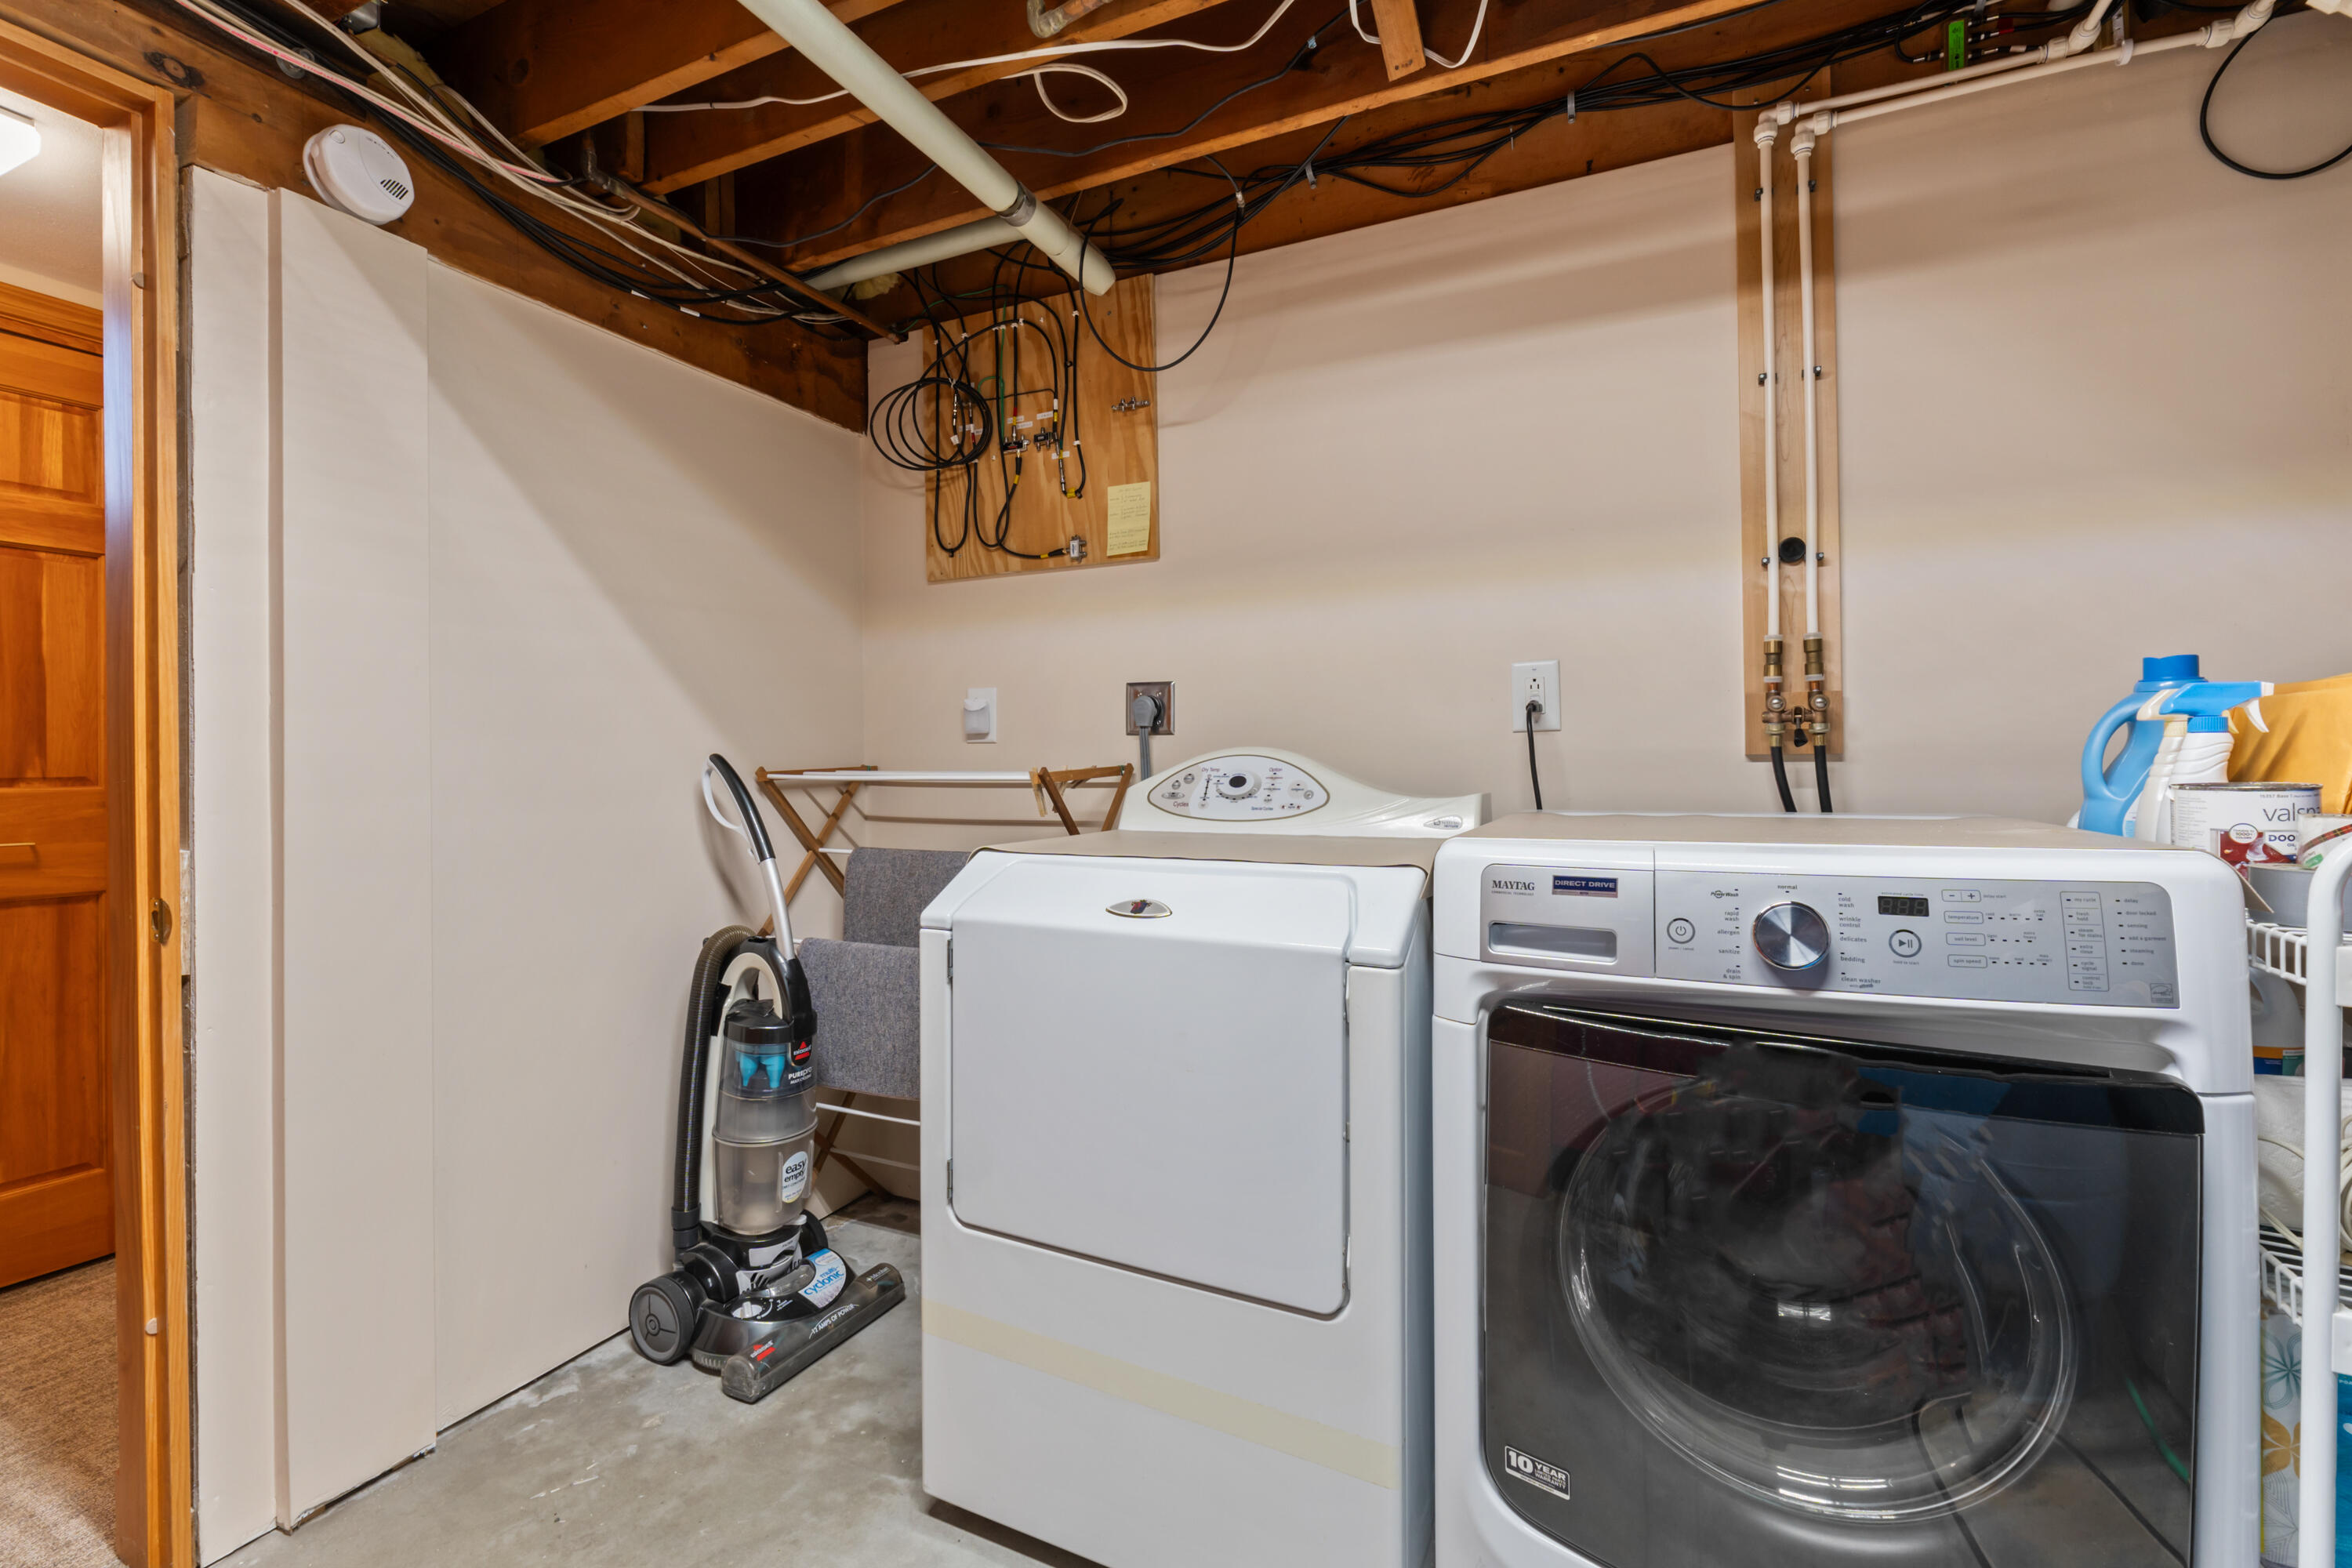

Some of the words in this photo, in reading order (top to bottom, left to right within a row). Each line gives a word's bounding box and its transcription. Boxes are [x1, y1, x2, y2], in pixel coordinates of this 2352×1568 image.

[1491, 880, 1535, 891] MAYTAG
[786, 1157, 807, 1174] easy
[804, 1269, 844, 1296] cyclonic
[818, 1319, 832, 1332] AMPS
[831, 1313, 839, 1322] OF
[838, 1304, 855, 1318] POWER
[1508, 1450, 1534, 1474] 10
[1534, 1461, 1566, 1481] YEAR
[1534, 1473, 1566, 1490] WARRANTY
